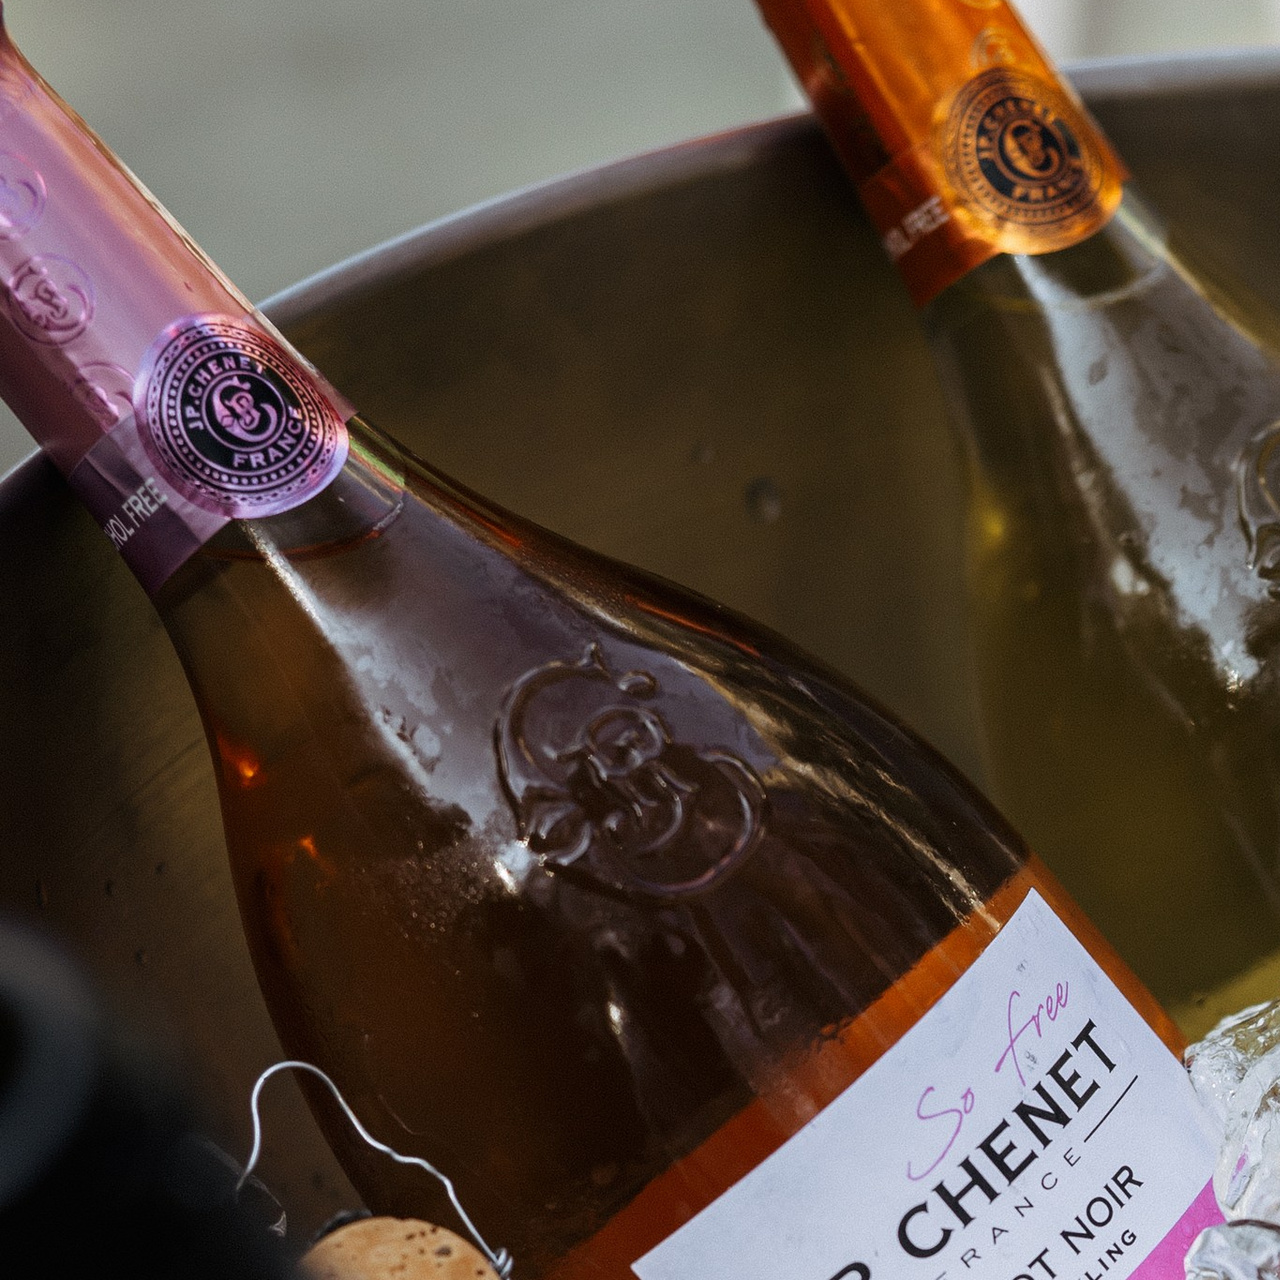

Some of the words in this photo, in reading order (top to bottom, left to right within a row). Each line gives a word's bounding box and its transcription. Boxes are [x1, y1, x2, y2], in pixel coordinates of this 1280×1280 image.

[232, 405, 303, 468] FRANCE
[103, 514, 135, 551] HOL
[122, 477, 168, 528] FREE
[906, 1085, 975, 1181] So
[994, 980, 1070, 1085] free
[897, 1018, 1117, 1260] CHENET
[1060, 1163, 1144, 1256] NOIR
